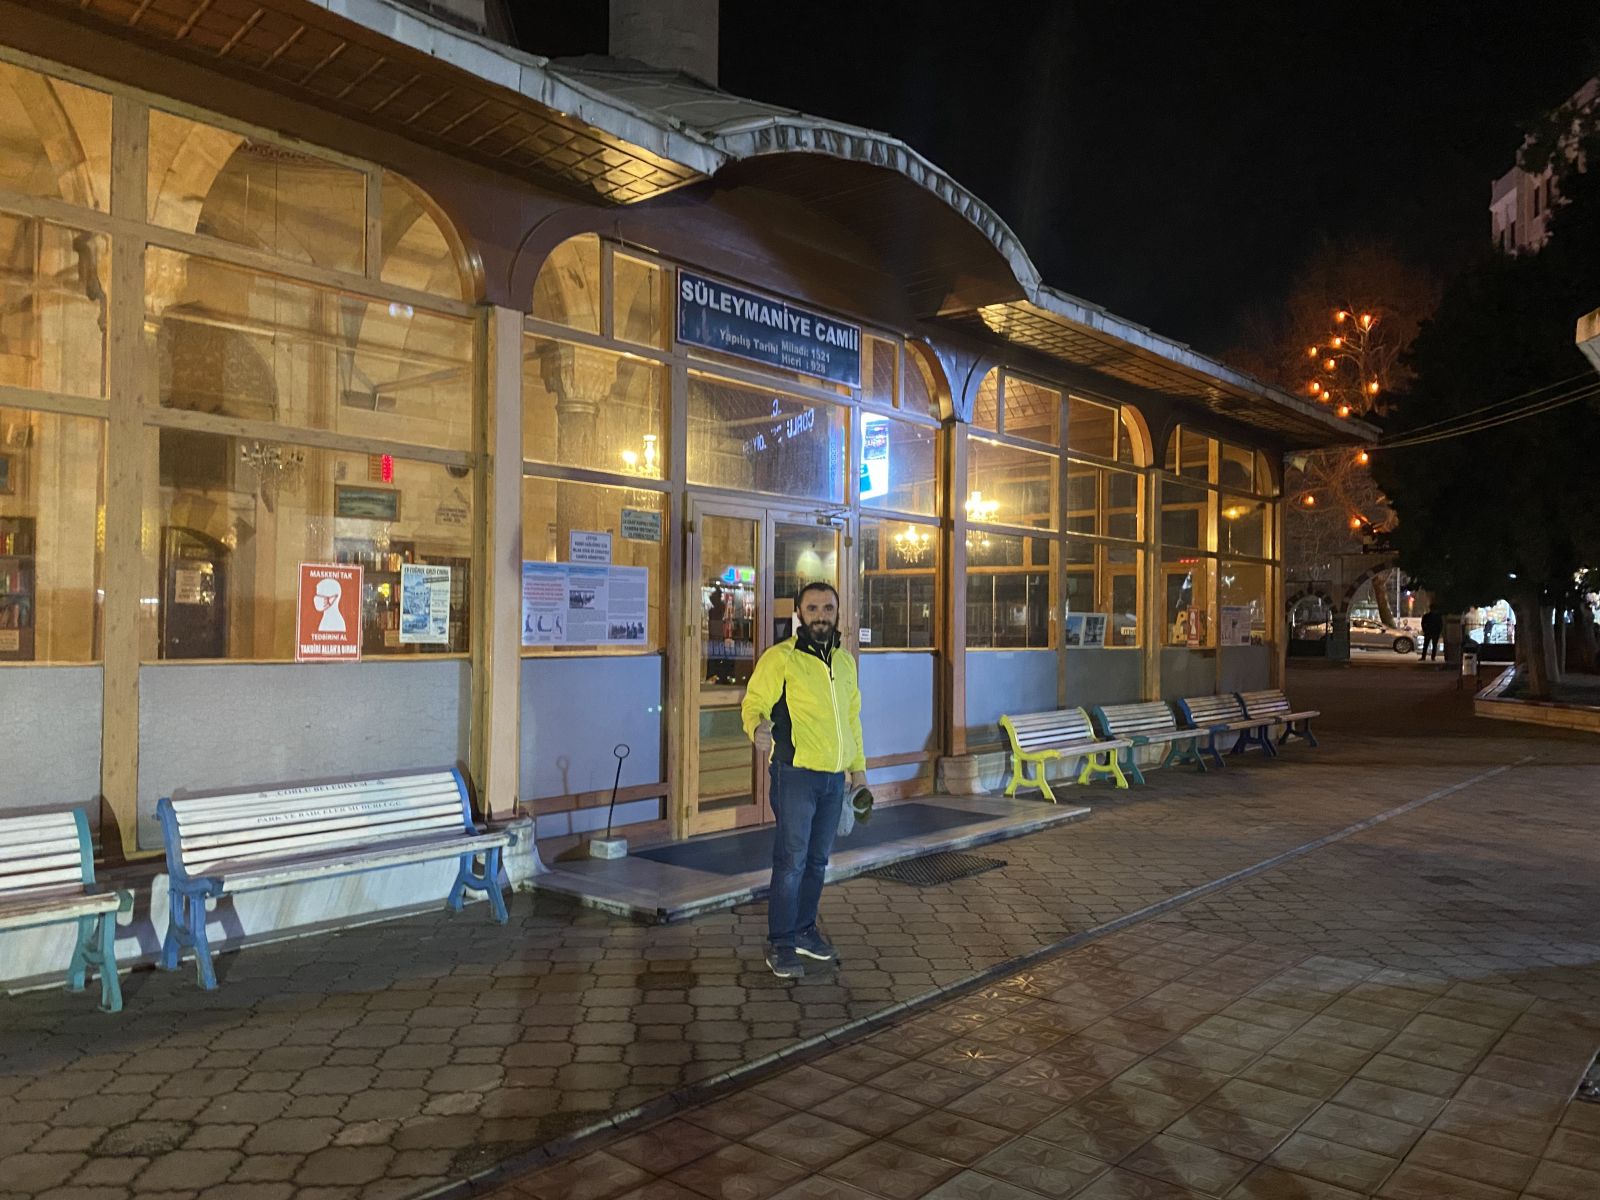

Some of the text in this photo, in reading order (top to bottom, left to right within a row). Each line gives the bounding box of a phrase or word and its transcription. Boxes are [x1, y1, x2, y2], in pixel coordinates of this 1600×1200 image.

[681, 280, 858, 351] SÜLEYMANİYE CAMİİ
[720, 328, 779, 355] Yapılış Tarihi
[811, 348, 831, 363] 1521
[310, 569, 353, 580] MASKENİ TAK
[311, 632, 339, 641] TEDBİRİNİ
